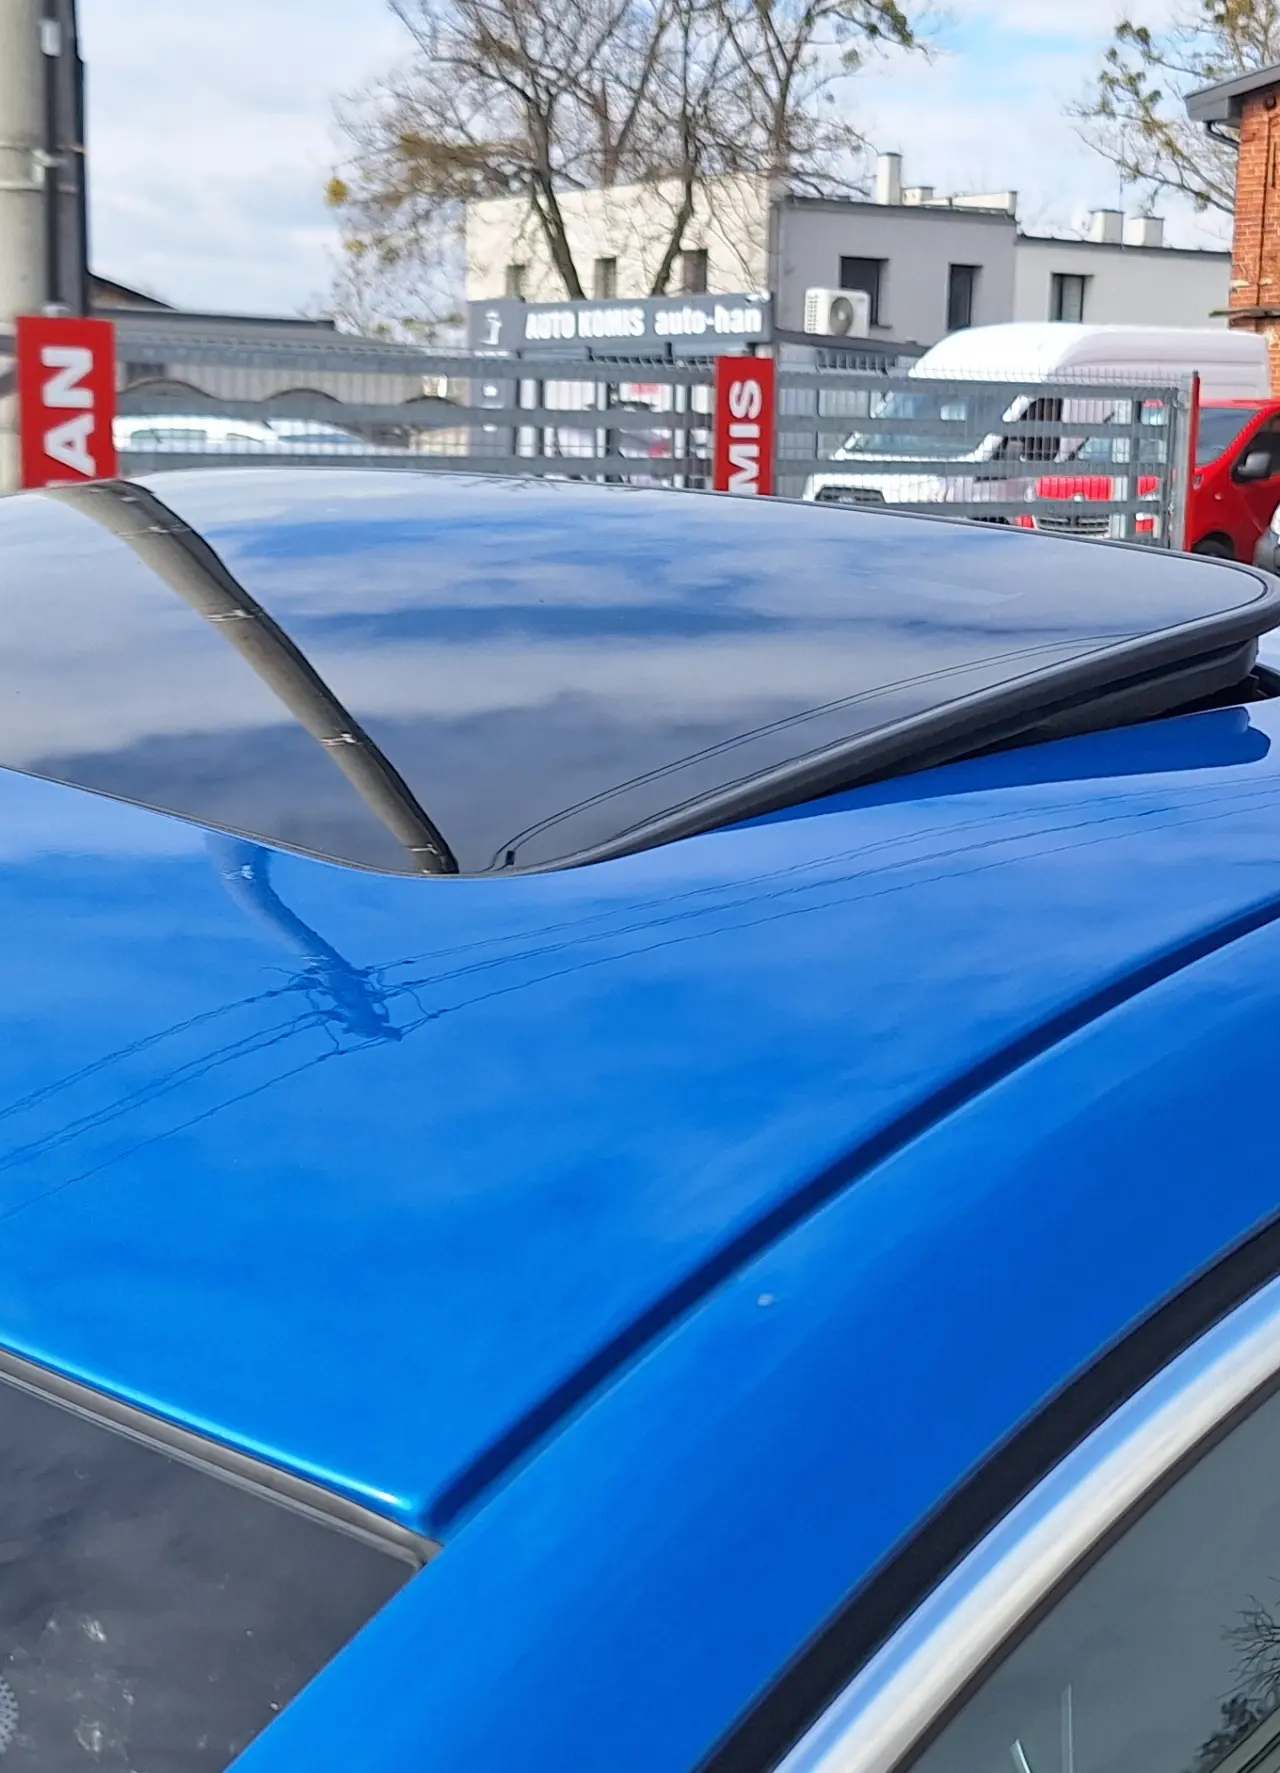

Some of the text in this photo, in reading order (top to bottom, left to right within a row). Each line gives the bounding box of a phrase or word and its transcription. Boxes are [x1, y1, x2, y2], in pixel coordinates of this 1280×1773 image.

[524, 304, 763, 339] AUTO KOMIS auto-han
[40, 346, 97, 488] AN
[728, 380, 762, 495] MIS
